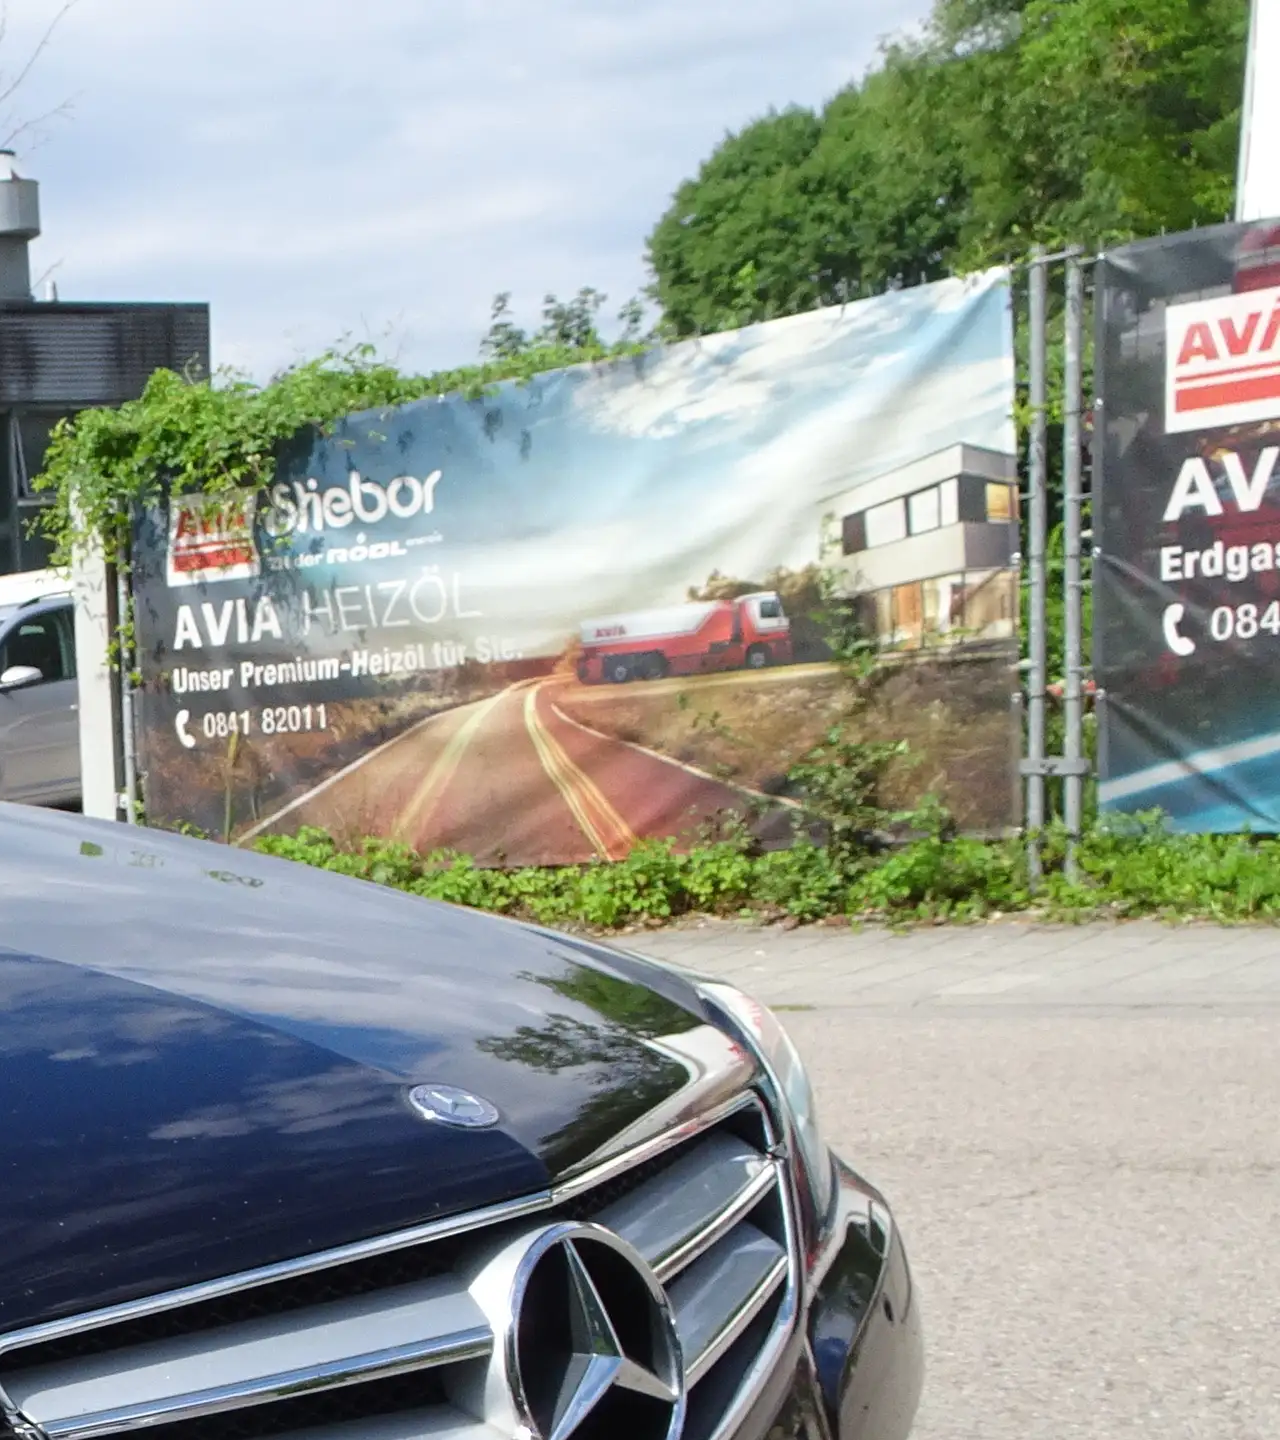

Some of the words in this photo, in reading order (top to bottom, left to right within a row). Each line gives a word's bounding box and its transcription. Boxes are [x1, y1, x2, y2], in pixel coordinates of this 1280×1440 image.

[1160, 541, 1280, 582] Erdga
[173, 596, 282, 650] AVIA
[301, 564, 483, 637] HEIZÖL
[173, 668, 234, 694] Unser
[241, 643, 425, 688] Premium-Heizöl
[203, 711, 250, 738] 0841
[261, 704, 327, 735] 82011
